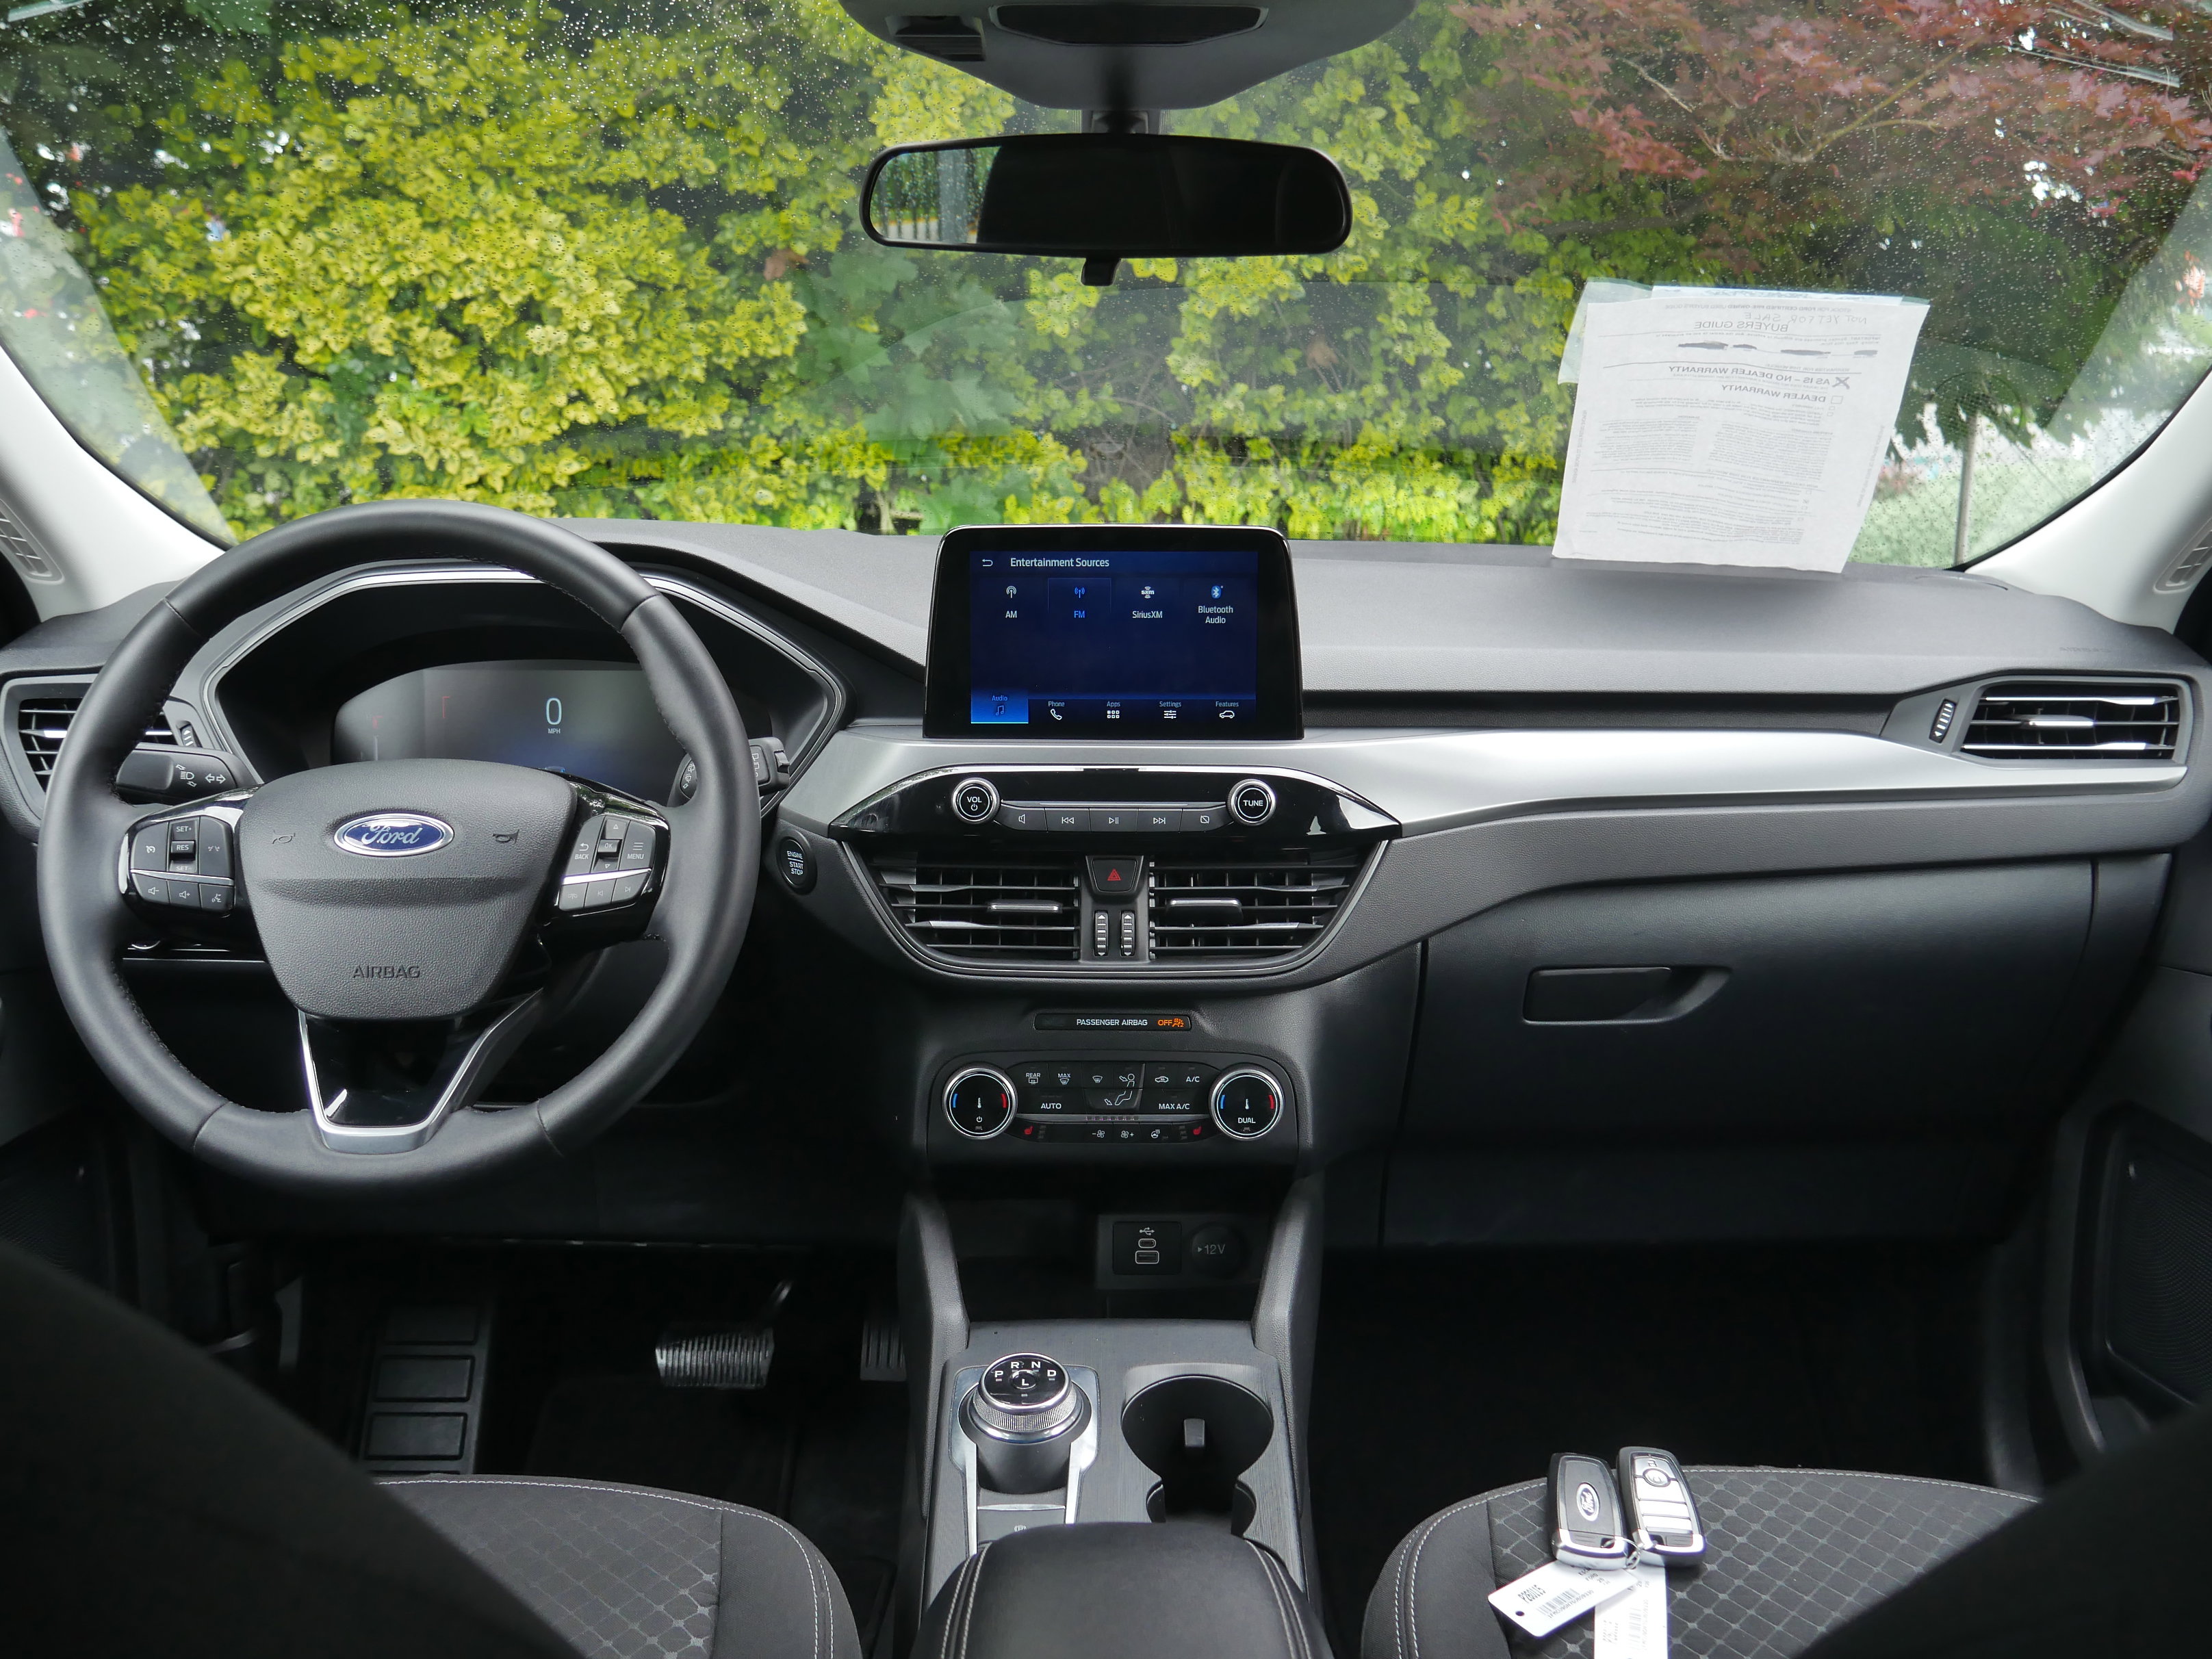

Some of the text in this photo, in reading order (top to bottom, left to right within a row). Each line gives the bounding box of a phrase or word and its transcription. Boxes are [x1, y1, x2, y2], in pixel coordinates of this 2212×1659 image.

[1010, 557, 1109, 567] Entertainment Sources
[1198, 605, 1233, 614] Bluetooth
[1132, 610, 1163, 619] SiriusXM
[1205, 615, 1226, 624] Audio
[1159, 700, 1182, 708] Settings
[546, 697, 562, 725] 0
[361, 823, 422, 845] Ford
[786, 851, 803, 859] ENGINE
[789, 861, 803, 869] START
[352, 964, 421, 979] AIRBAG
[1076, 1018, 1120, 1027] PASSENGER
[1122, 1018, 1148, 1027] AIRBAG
[1186, 1075, 1200, 1083] A/C
[1205, 1244, 1226, 1255] 12V
[994, 1370, 1005, 1378] P
[1031, 1361, 1041, 1369] N
